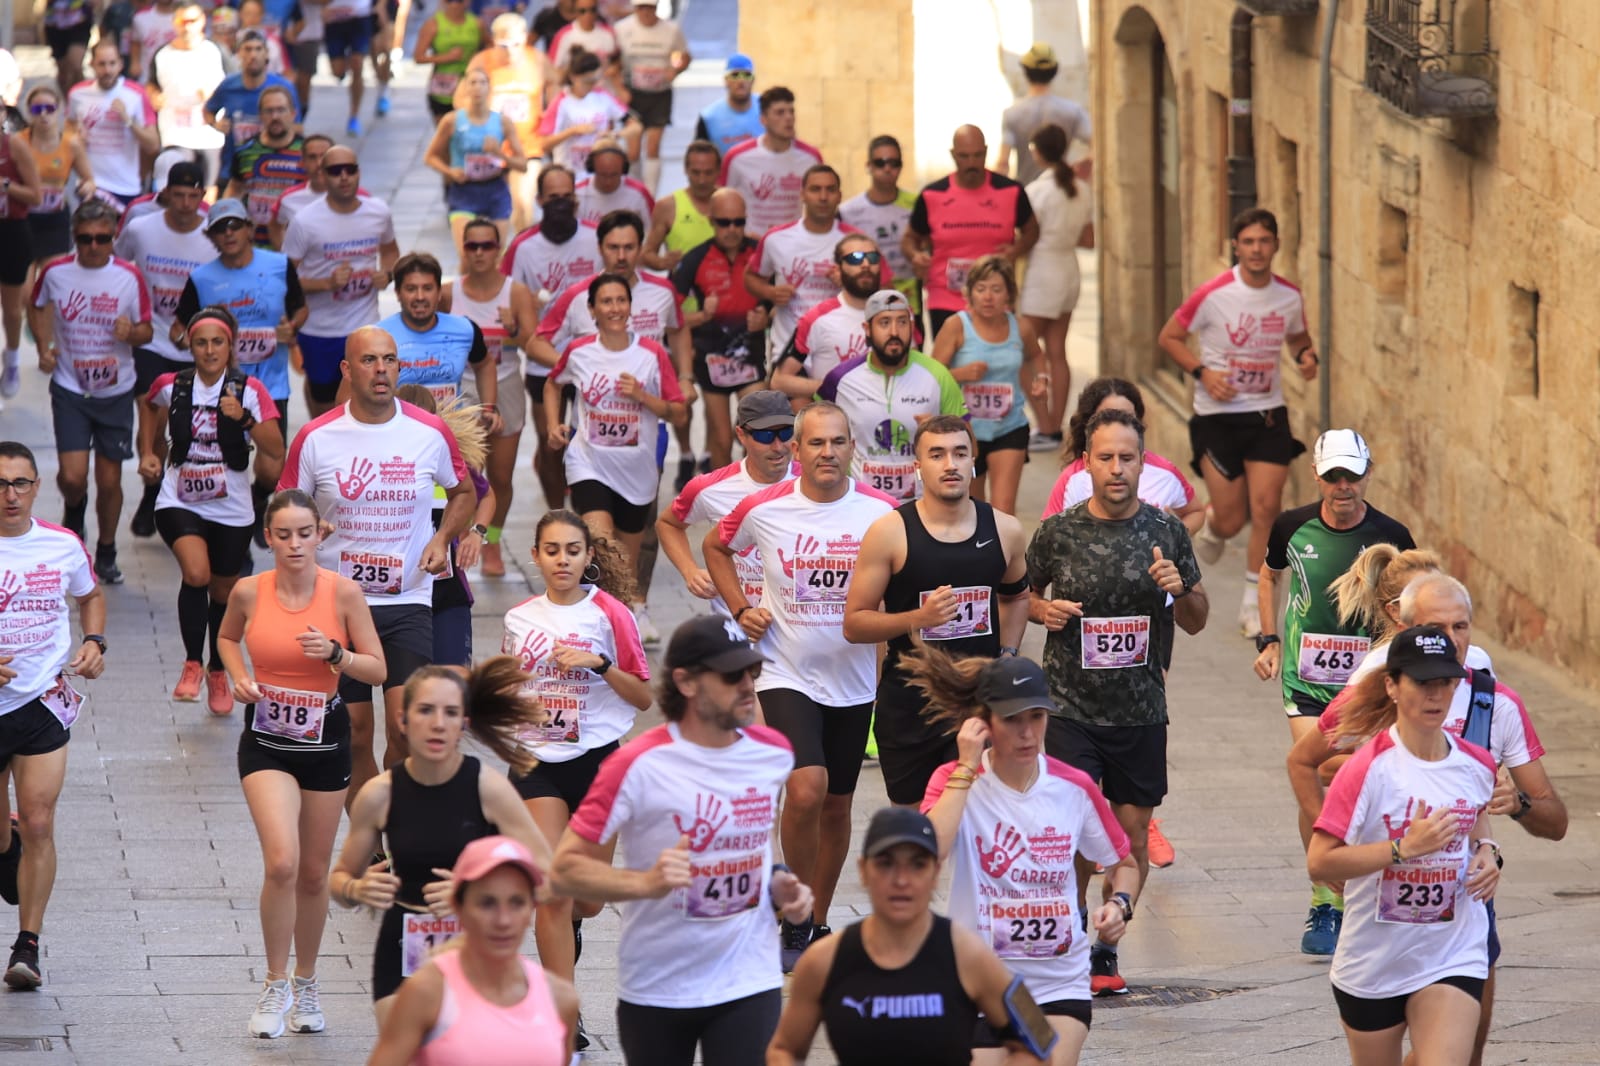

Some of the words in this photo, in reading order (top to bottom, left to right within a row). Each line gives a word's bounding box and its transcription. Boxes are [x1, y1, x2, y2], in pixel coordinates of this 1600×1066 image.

[239, 340, 265, 352] 276
[83, 366, 110, 381] 166
[1238, 370, 1265, 384] 271
[973, 395, 1002, 408] 315
[598, 422, 629, 437] 349
[185, 478, 215, 493] 300
[872, 475, 903, 490] 351
[365, 489, 417, 502] CARRERA
[340, 551, 403, 569] bedunia
[352, 564, 389, 583] 235
[808, 569, 849, 588] 407
[1083, 620, 1149, 634] bedunia
[1097, 633, 1136, 653] 520
[1303, 637, 1368, 652] bedunia
[1415, 635, 1446, 647] Savia
[1314, 651, 1354, 670] 463
[268, 702, 308, 726] 318
[1383, 867, 1457, 885] bedunia
[704, 873, 750, 900] 410
[1397, 883, 1444, 908] 233
[992, 902, 1070, 919] bedunia
[1011, 918, 1058, 942] 232
[871, 993, 944, 1019] PUMA
